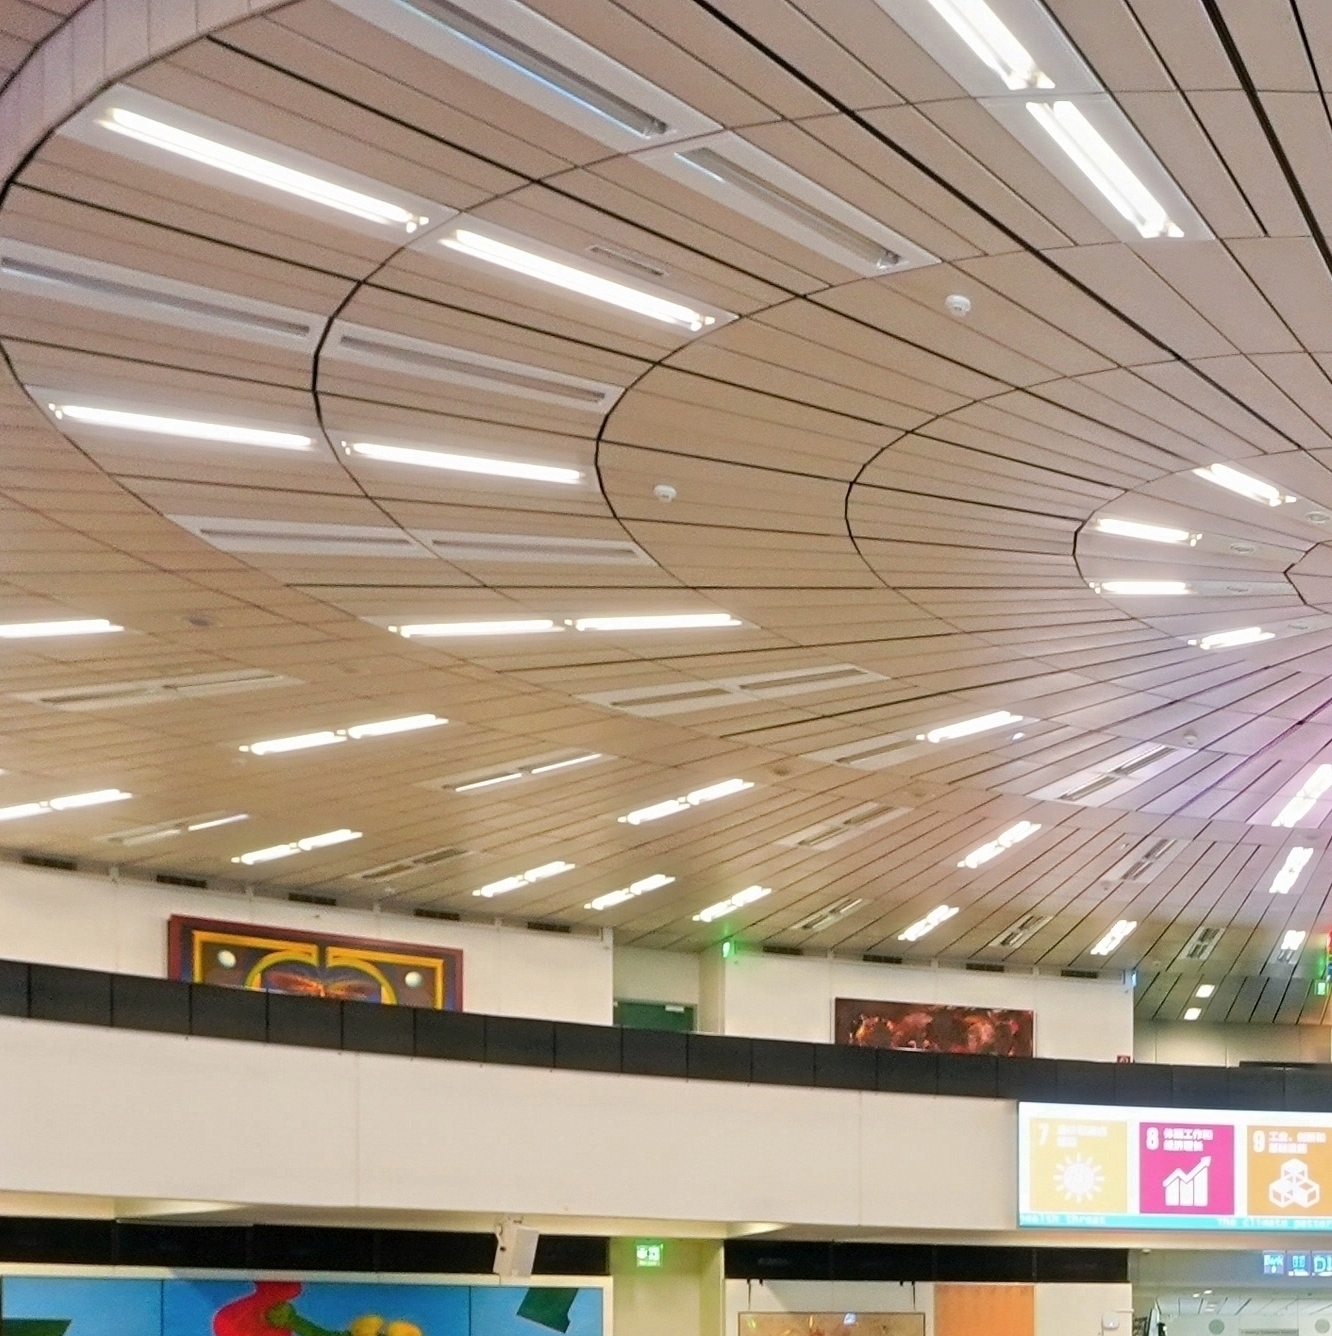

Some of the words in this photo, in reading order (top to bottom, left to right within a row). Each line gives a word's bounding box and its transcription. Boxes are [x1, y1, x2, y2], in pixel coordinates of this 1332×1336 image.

[1037, 1122, 1050, 1147] 7
[1146, 1127, 1159, 1150] 8
[1253, 1130, 1265, 1153] 9
[1314, 1256, 1326, 1272] D
